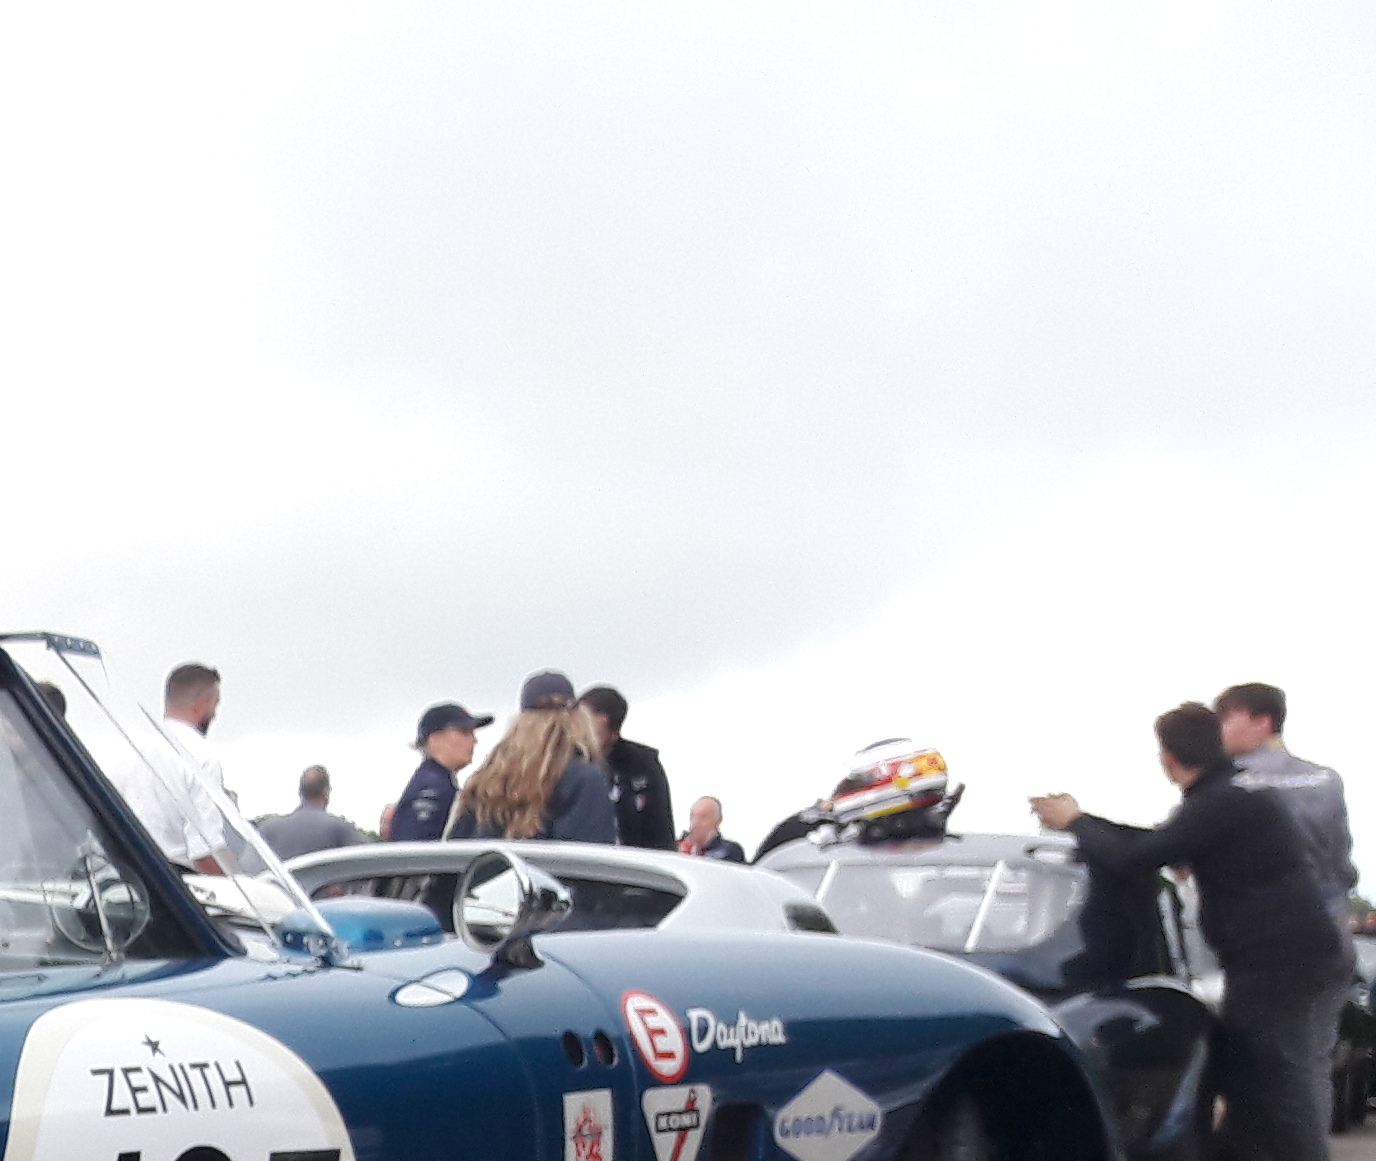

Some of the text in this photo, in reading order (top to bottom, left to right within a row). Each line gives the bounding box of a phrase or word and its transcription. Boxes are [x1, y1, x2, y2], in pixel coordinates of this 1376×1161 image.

[634, 1005, 677, 1061] E
[685, 1007, 787, 1064] Daytona
[89, 1059, 255, 1118] ZENITH
